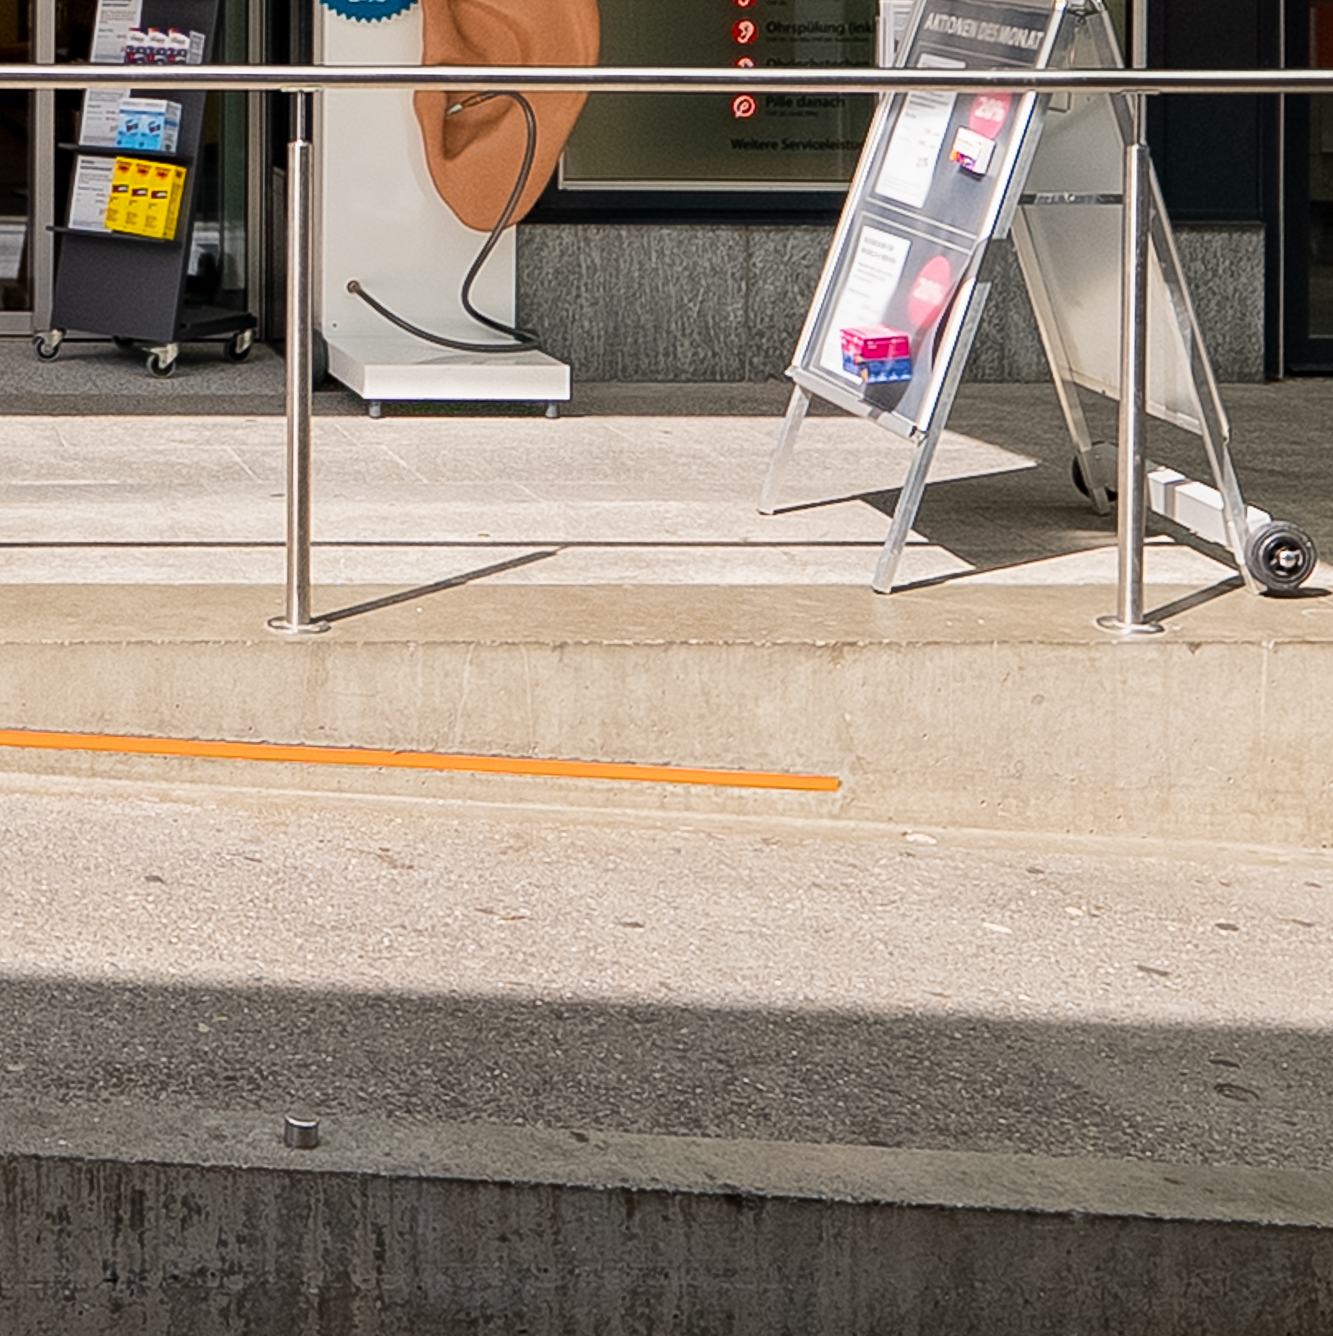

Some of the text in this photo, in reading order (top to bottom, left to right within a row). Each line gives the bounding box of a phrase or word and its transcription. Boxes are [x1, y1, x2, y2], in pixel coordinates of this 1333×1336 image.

[766, 20, 845, 35] Ohrspülung
[924, 11, 978, 38] AKTIONEN
[976, 21, 1001, 43] DES
[796, 95, 846, 108] danach
[731, 138, 779, 150] Weitere
